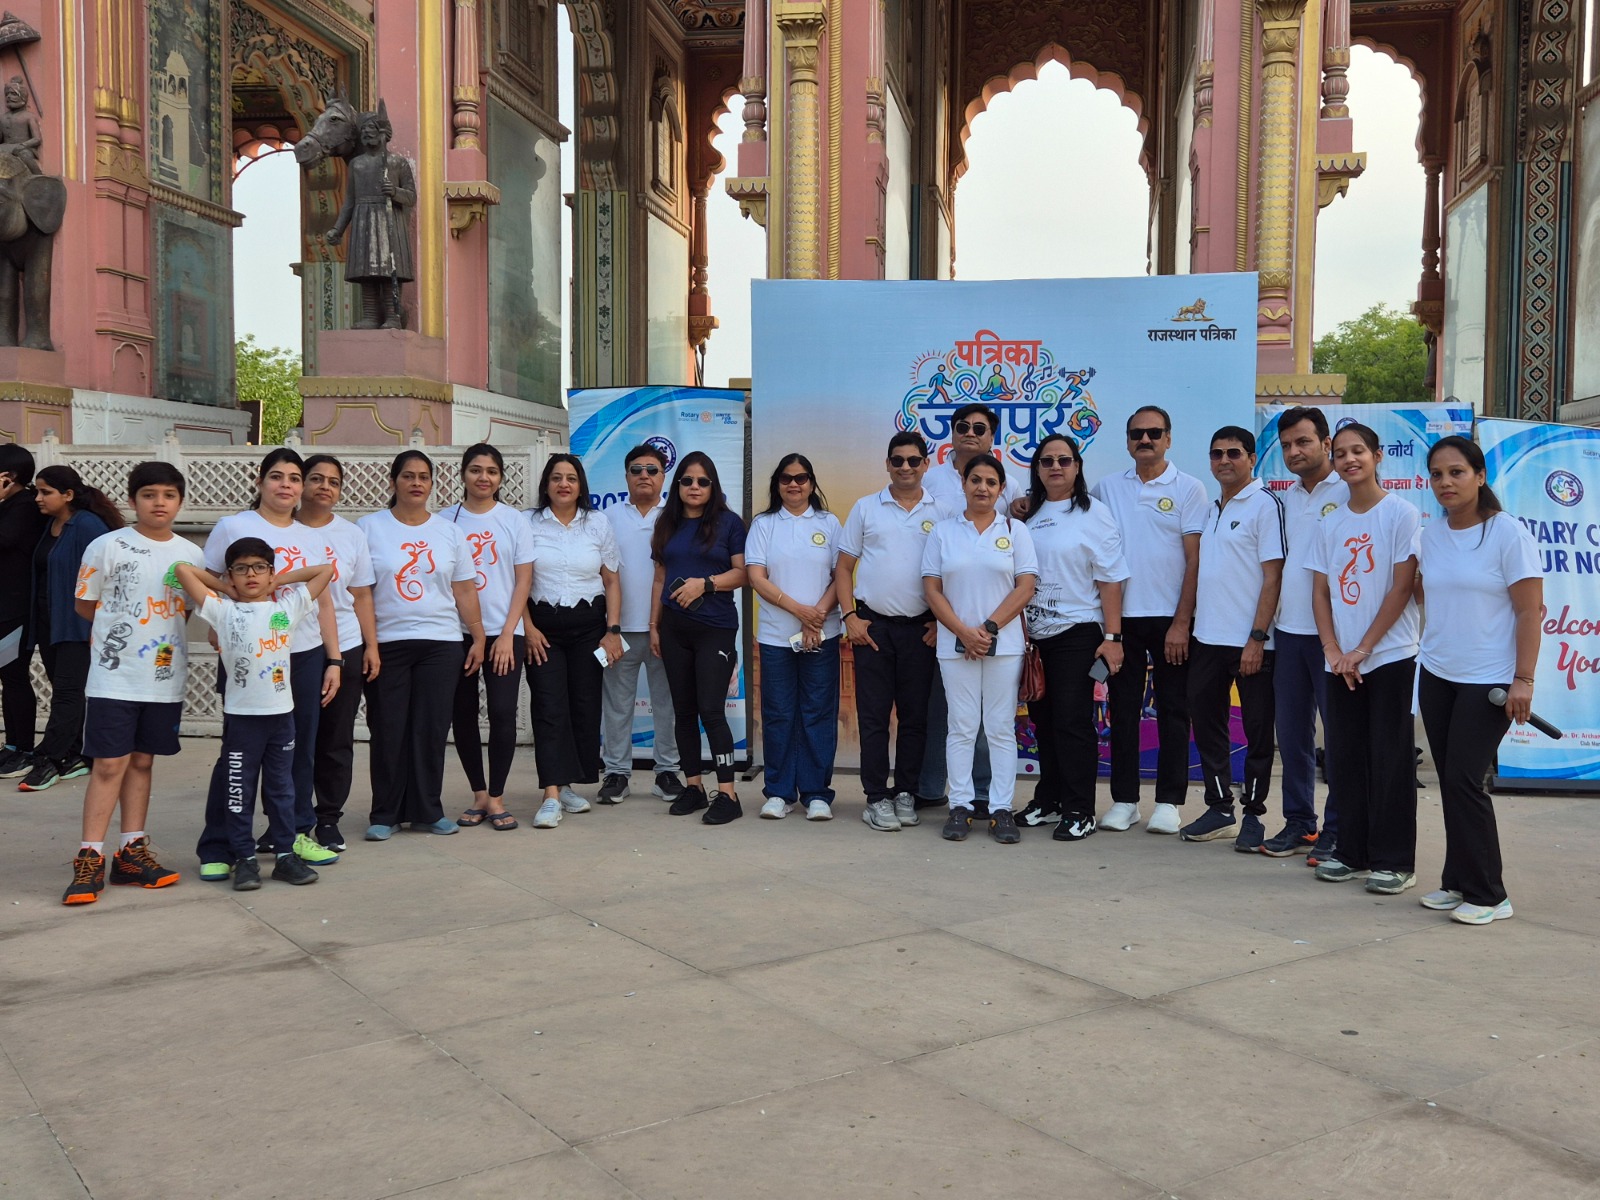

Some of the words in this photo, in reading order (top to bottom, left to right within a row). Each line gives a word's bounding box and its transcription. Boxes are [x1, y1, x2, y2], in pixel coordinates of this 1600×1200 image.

[955, 329, 1042, 366] पत्रिका
[1148, 329, 1197, 341] राजस्थान
[1199, 324, 1237, 341] पत्रिका
[918, 403, 1072, 463] जपुर
[1387, 439, 1414, 457] नोर्थ
[1382, 479, 1412, 490] करता
[1518, 516, 1578, 545] TARY
[1540, 604, 1600, 635] elco
[228, 752, 243, 813] HOLLISTER
